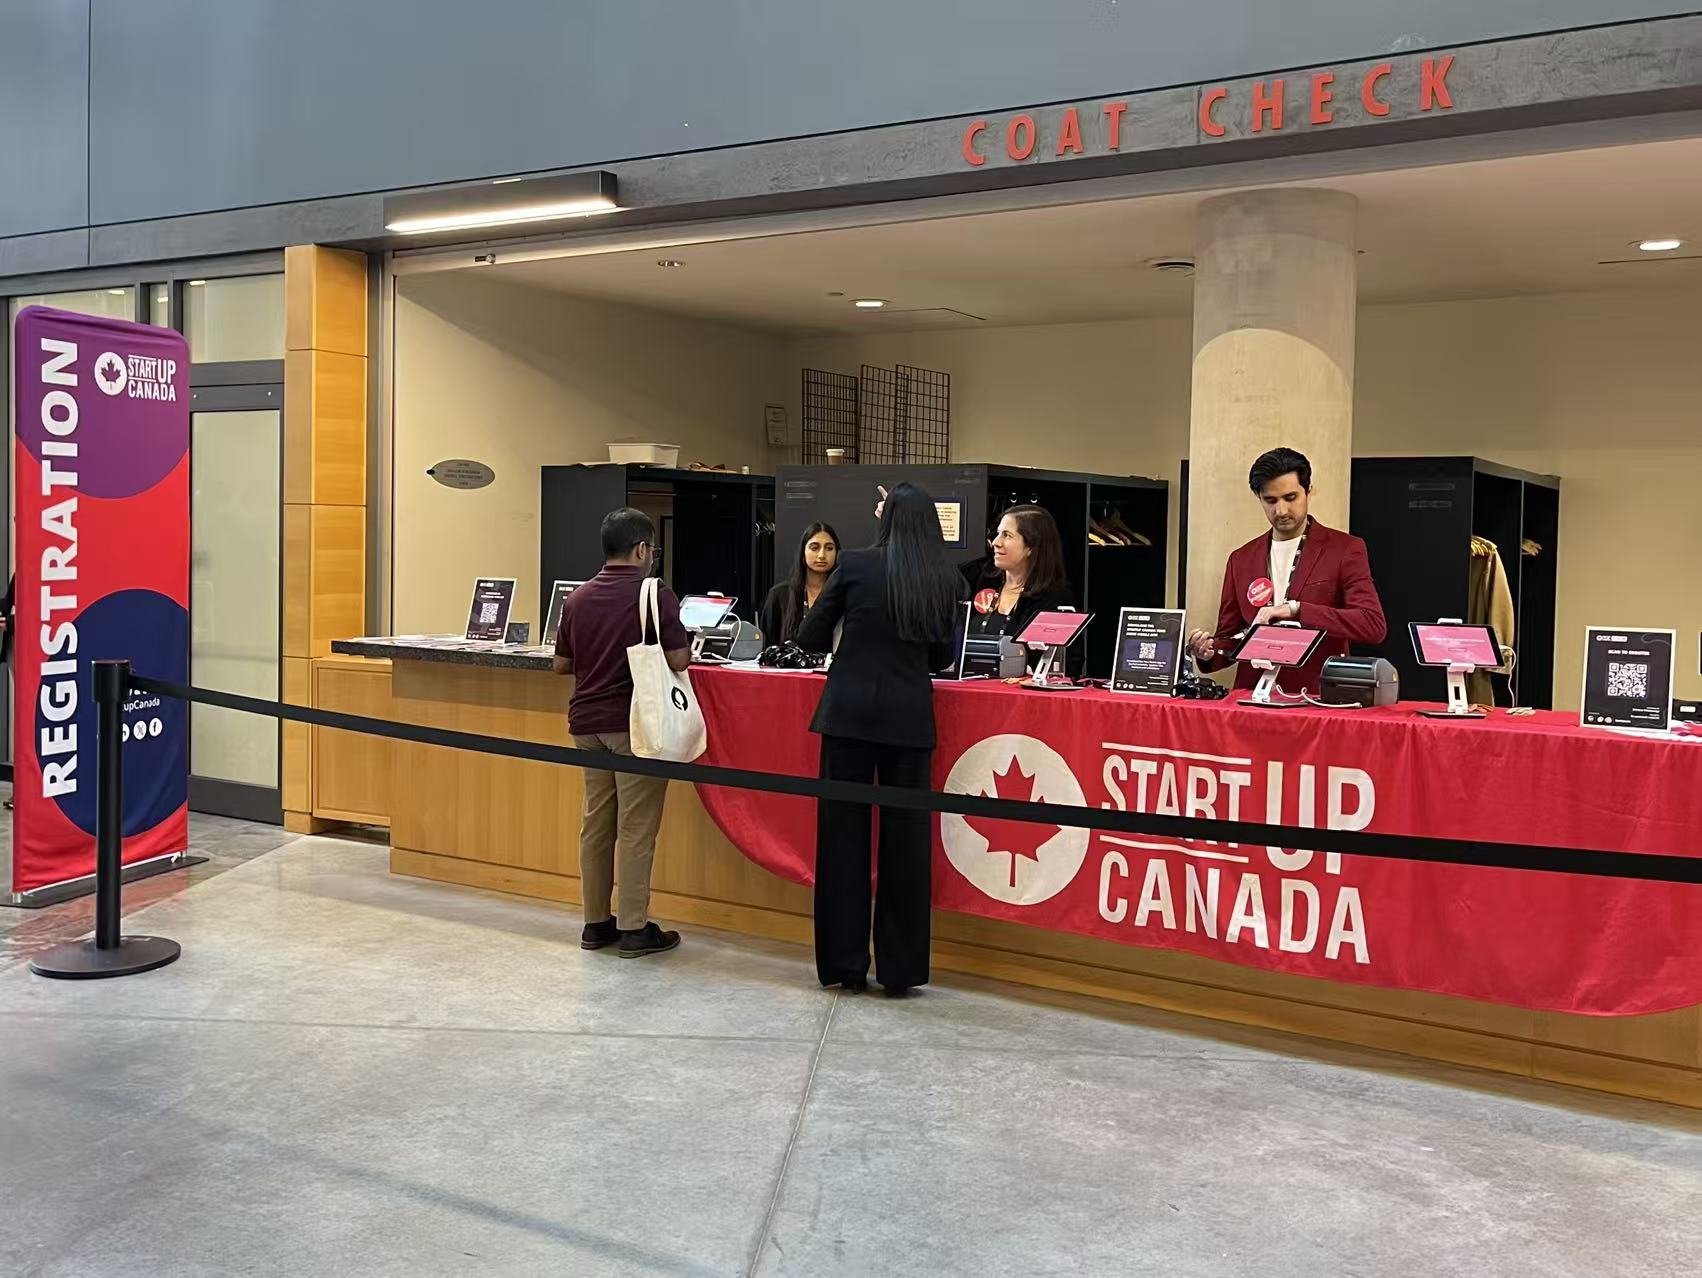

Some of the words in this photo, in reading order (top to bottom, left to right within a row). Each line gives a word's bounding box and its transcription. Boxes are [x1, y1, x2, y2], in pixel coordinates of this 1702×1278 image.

[963, 102, 1126, 165] COAT
[1199, 56, 1453, 136] CHECK
[128, 380, 176, 402] CANADA
[40, 337, 79, 798] REGISTRATION
[122, 697, 160, 713] upCanada
[1098, 850, 1371, 964] CANADA
